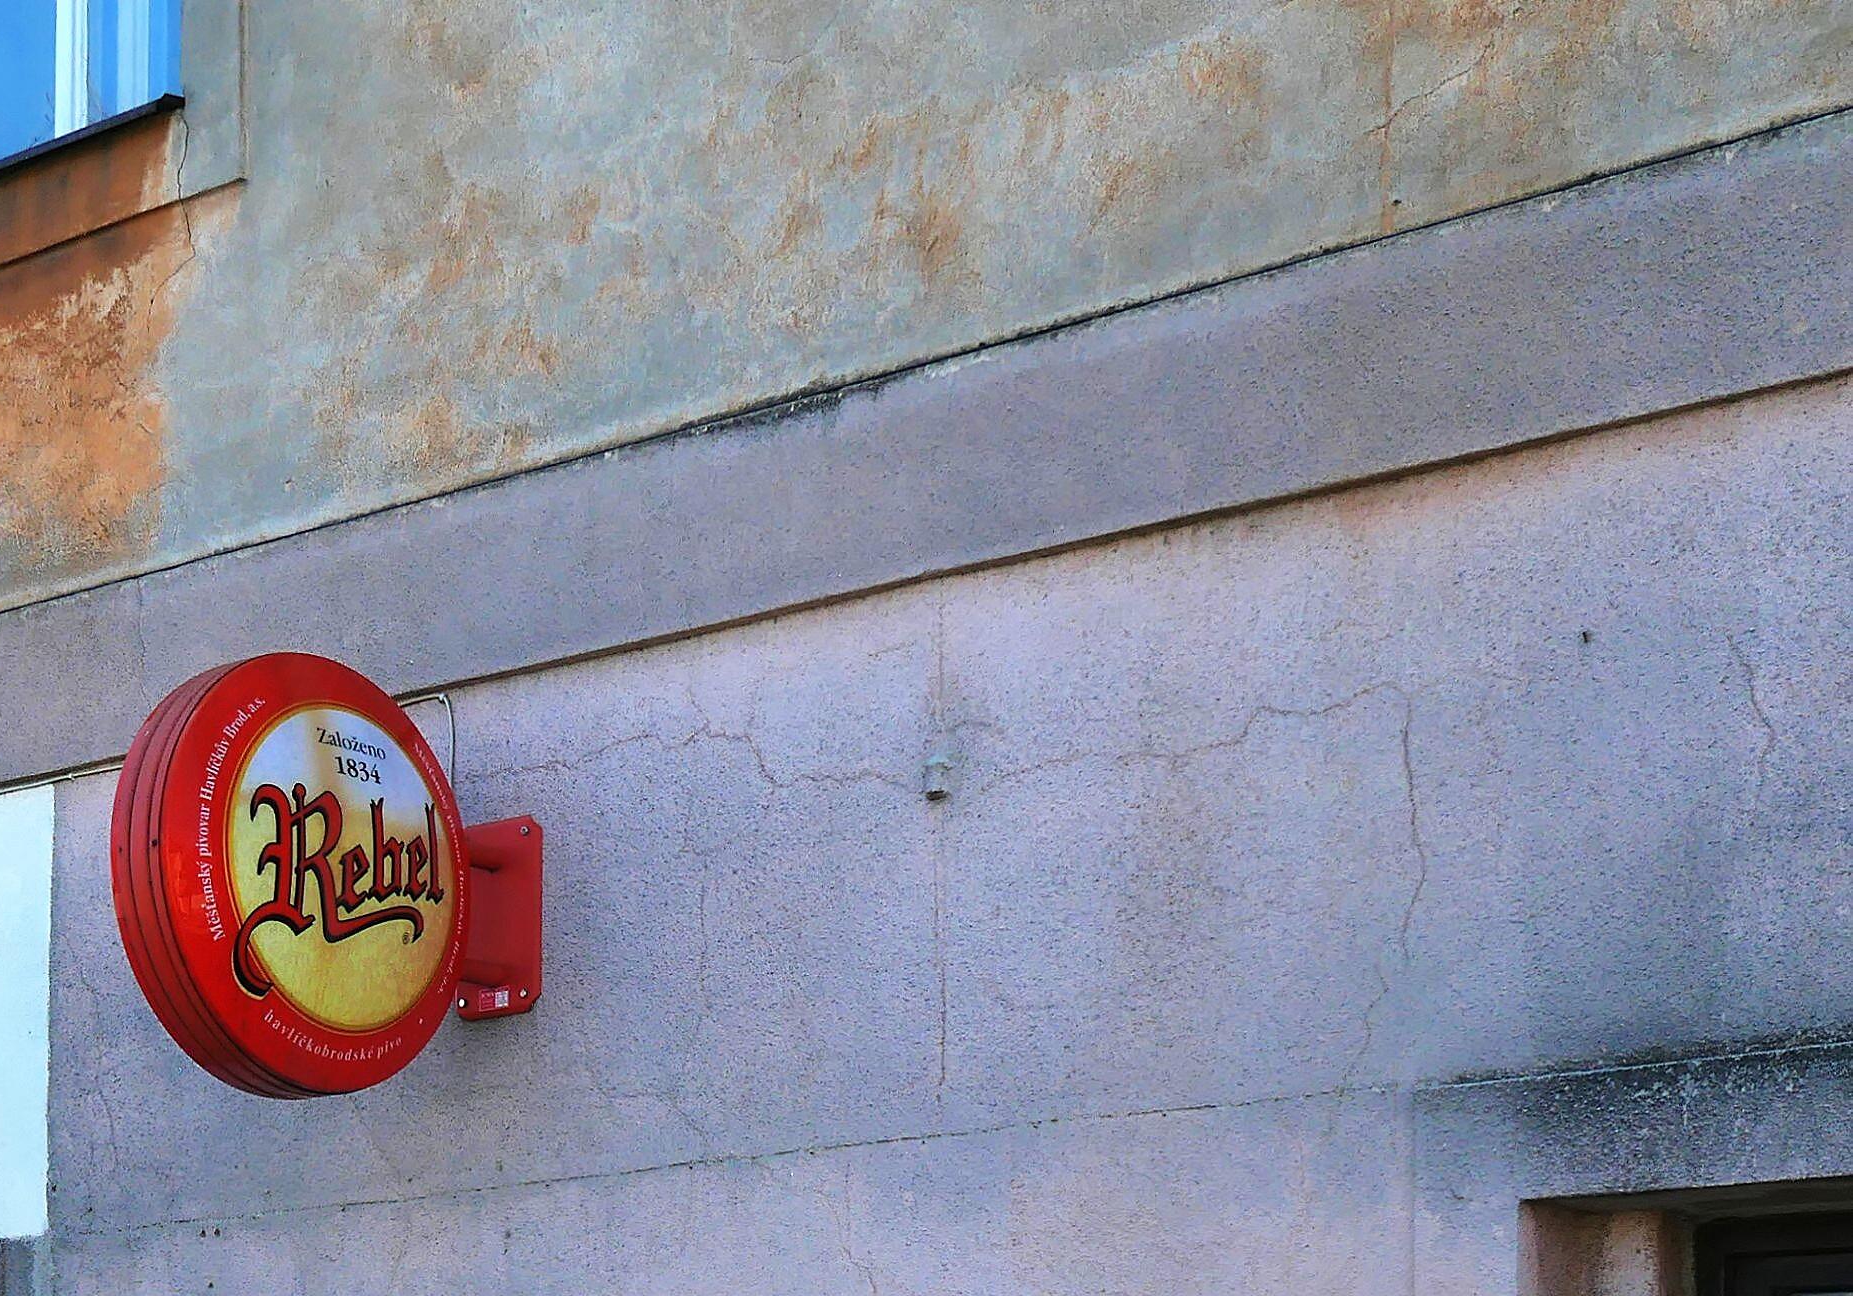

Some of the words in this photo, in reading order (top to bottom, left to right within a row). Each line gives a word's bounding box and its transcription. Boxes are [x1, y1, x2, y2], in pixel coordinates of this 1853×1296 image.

[316, 727, 386, 760] Založeno
[334, 756, 382, 785] 1834
[195, 804, 212, 857] pivovar
[233, 783, 444, 999] Rebel
[377, 1036, 403, 1060] pivo
